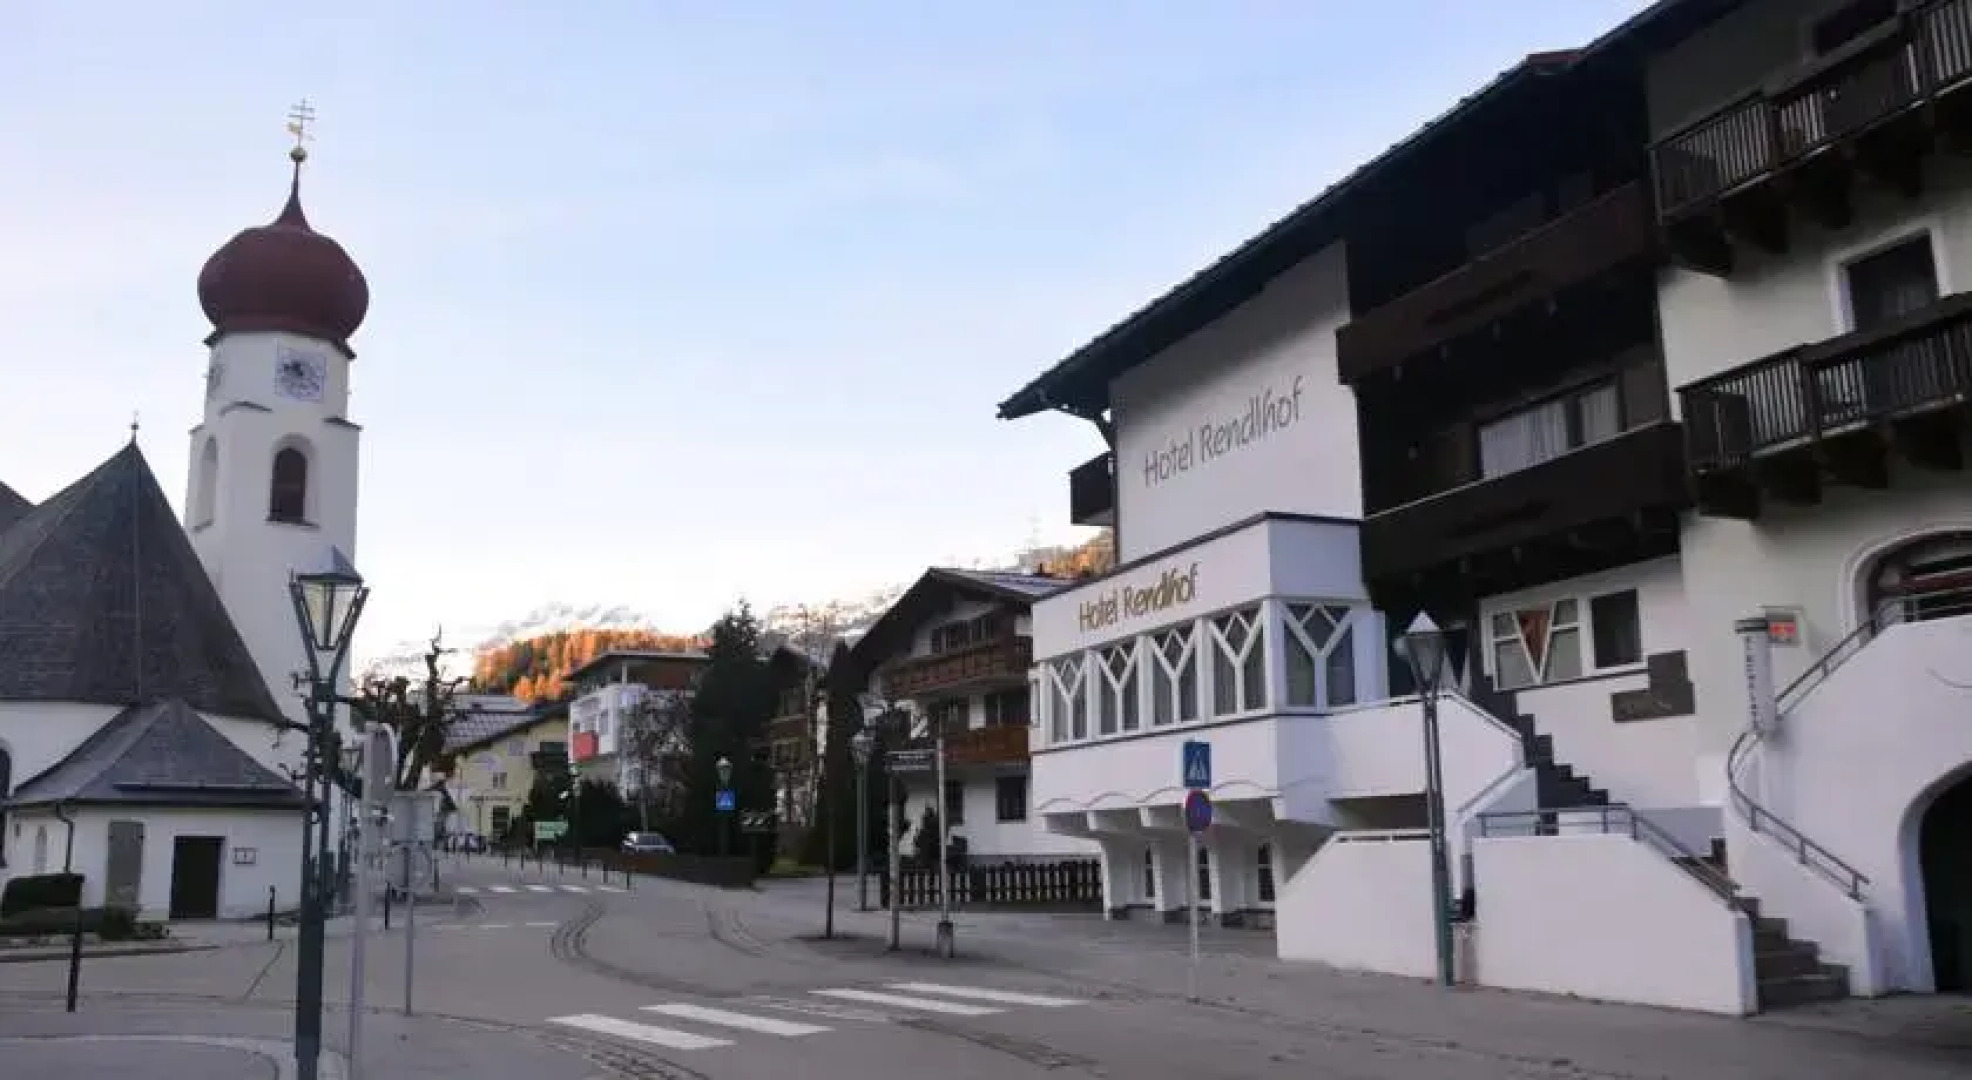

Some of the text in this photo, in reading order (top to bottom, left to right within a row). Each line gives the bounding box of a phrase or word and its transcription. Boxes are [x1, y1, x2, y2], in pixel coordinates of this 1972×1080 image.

[1144, 375, 1304, 488] Hotel Rendlhof
[1079, 562, 1198, 632] Hotel Rendlhof
